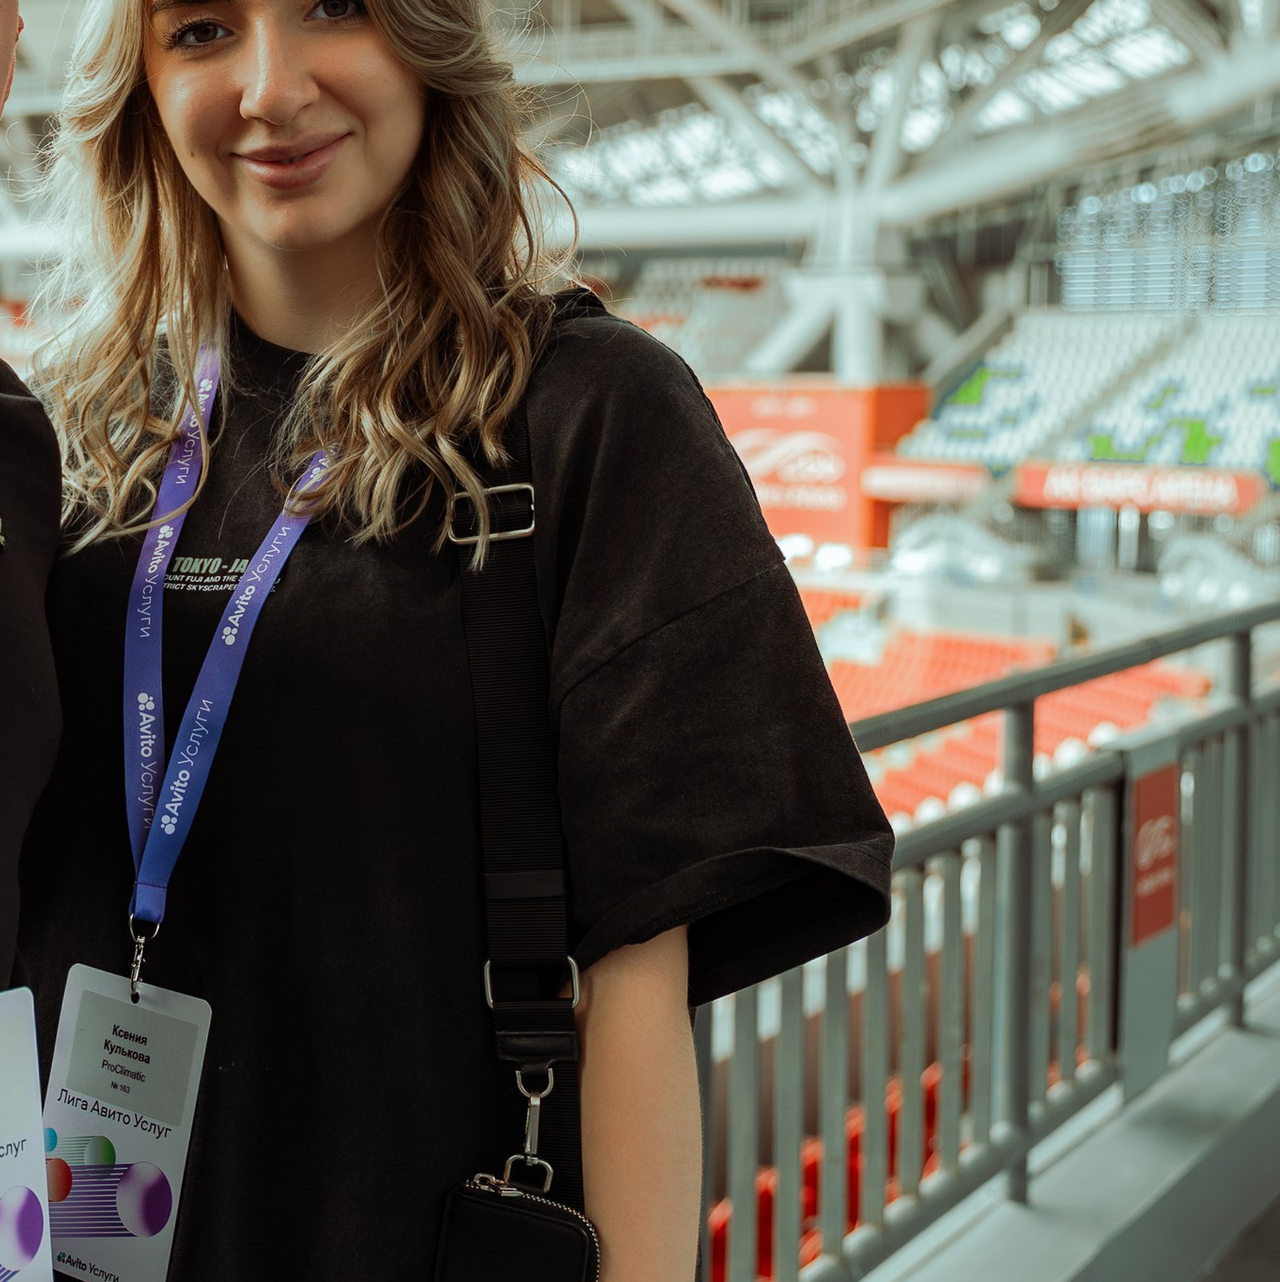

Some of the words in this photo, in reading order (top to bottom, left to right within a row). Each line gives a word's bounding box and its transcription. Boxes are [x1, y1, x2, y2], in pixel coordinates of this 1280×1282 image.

[175, 428, 201, 484] Услуги
[147, 539, 170, 574] Avito
[172, 557, 223, 574] TOKYO
[185, 575, 203, 583] FUJI
[227, 585, 256, 627] Avito
[247, 526, 291, 582] Услуги
[138, 573, 159, 638] Услуги
[139, 711, 156, 758] Avito
[165, 770, 191, 816] Avito
[178, 699, 213, 766] Услуги
[138, 761, 157, 829] Услуги
[103, 1039, 151, 1064] Кулькова
[112, 1024, 148, 1046] Ксения
[101, 1059, 146, 1082] ProClimatic
[119, 1083, 131, 1094] 163
[57, 1088, 89, 1111] Лига
[90, 1100, 131, 1125] Авито
[133, 1113, 172, 1139] Услуг
[65, 1254, 87, 1271] Avito
